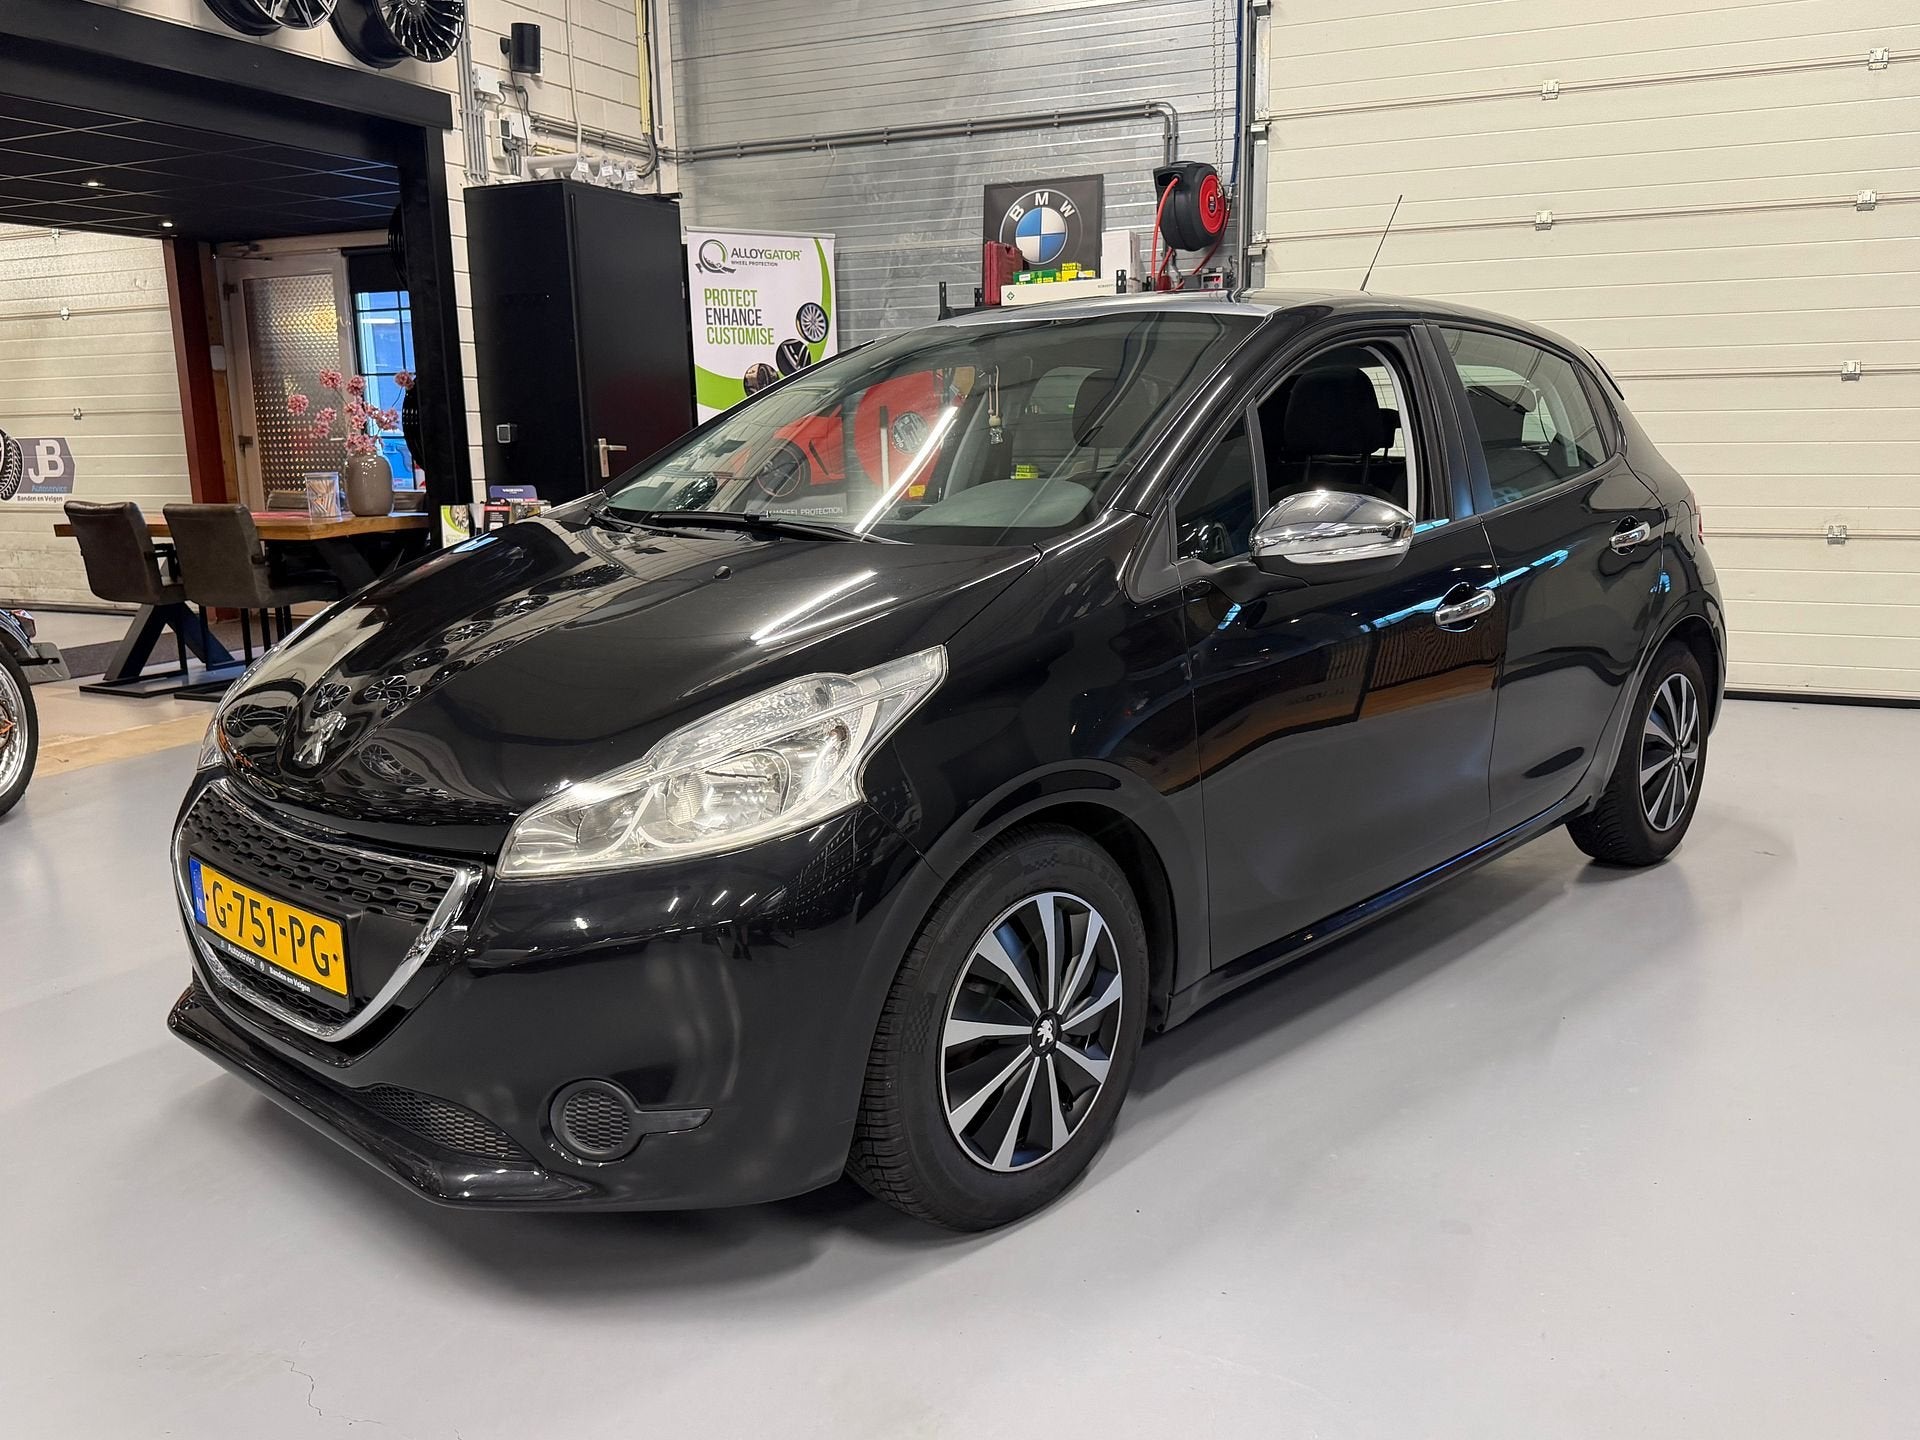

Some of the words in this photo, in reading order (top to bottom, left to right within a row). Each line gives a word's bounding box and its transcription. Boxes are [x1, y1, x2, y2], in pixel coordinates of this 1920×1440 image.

[1009, 192, 1076, 222] BMW
[731, 248, 801, 261] ALLOYGATOR
[704, 288, 757, 307] PROTECT
[706, 308, 762, 326] ENHANCE
[707, 327, 775, 345] CUSTOMISE
[28, 439, 64, 484] JB
[212, 881, 330, 977] G-751-PG
